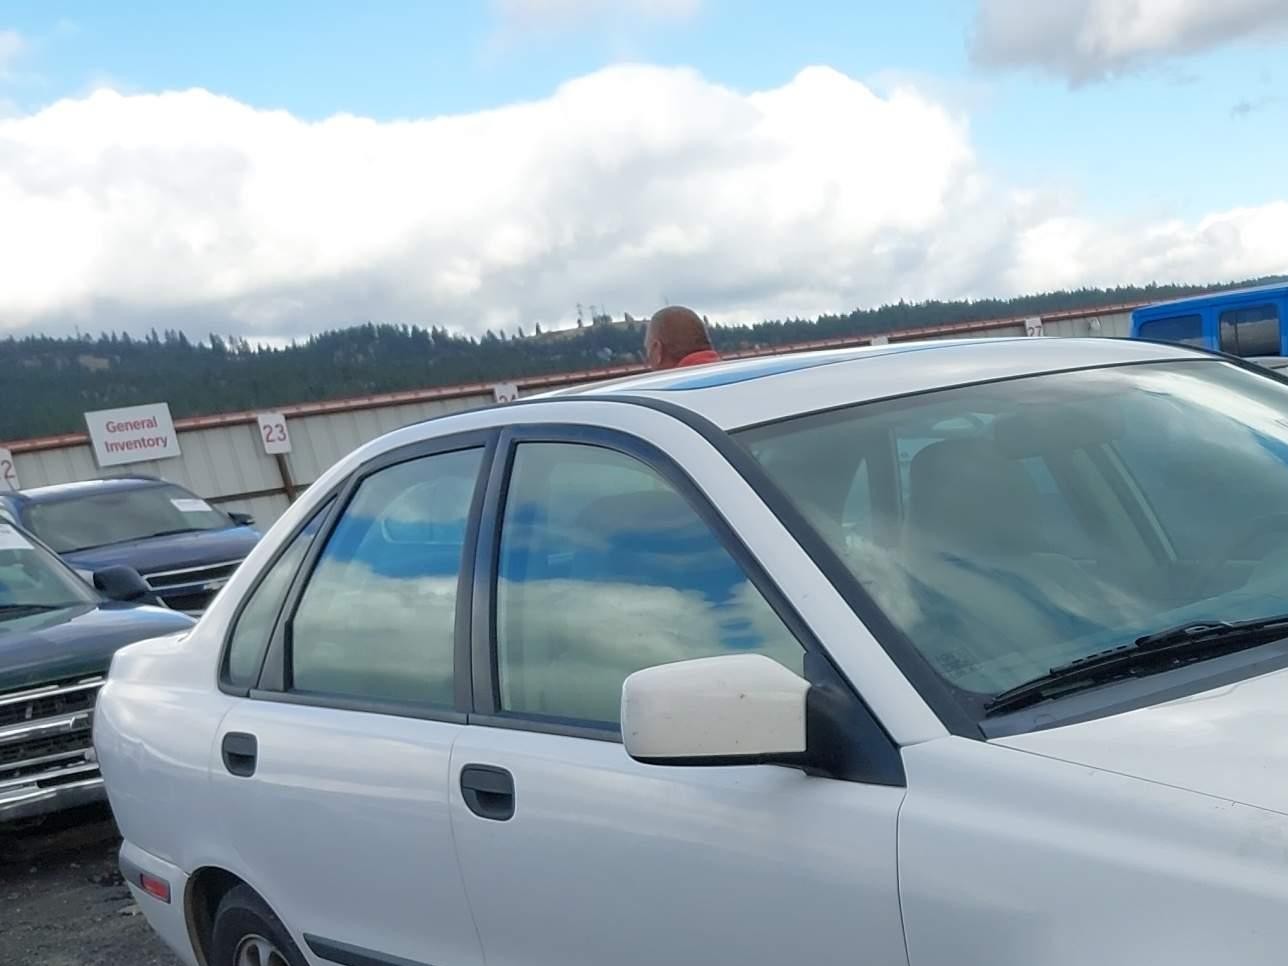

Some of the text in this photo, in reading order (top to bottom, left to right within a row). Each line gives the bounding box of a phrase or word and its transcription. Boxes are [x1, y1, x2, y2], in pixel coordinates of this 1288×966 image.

[105, 416, 158, 433] General
[263, 424, 287, 443] 23
[104, 435, 168, 453] Inventory
